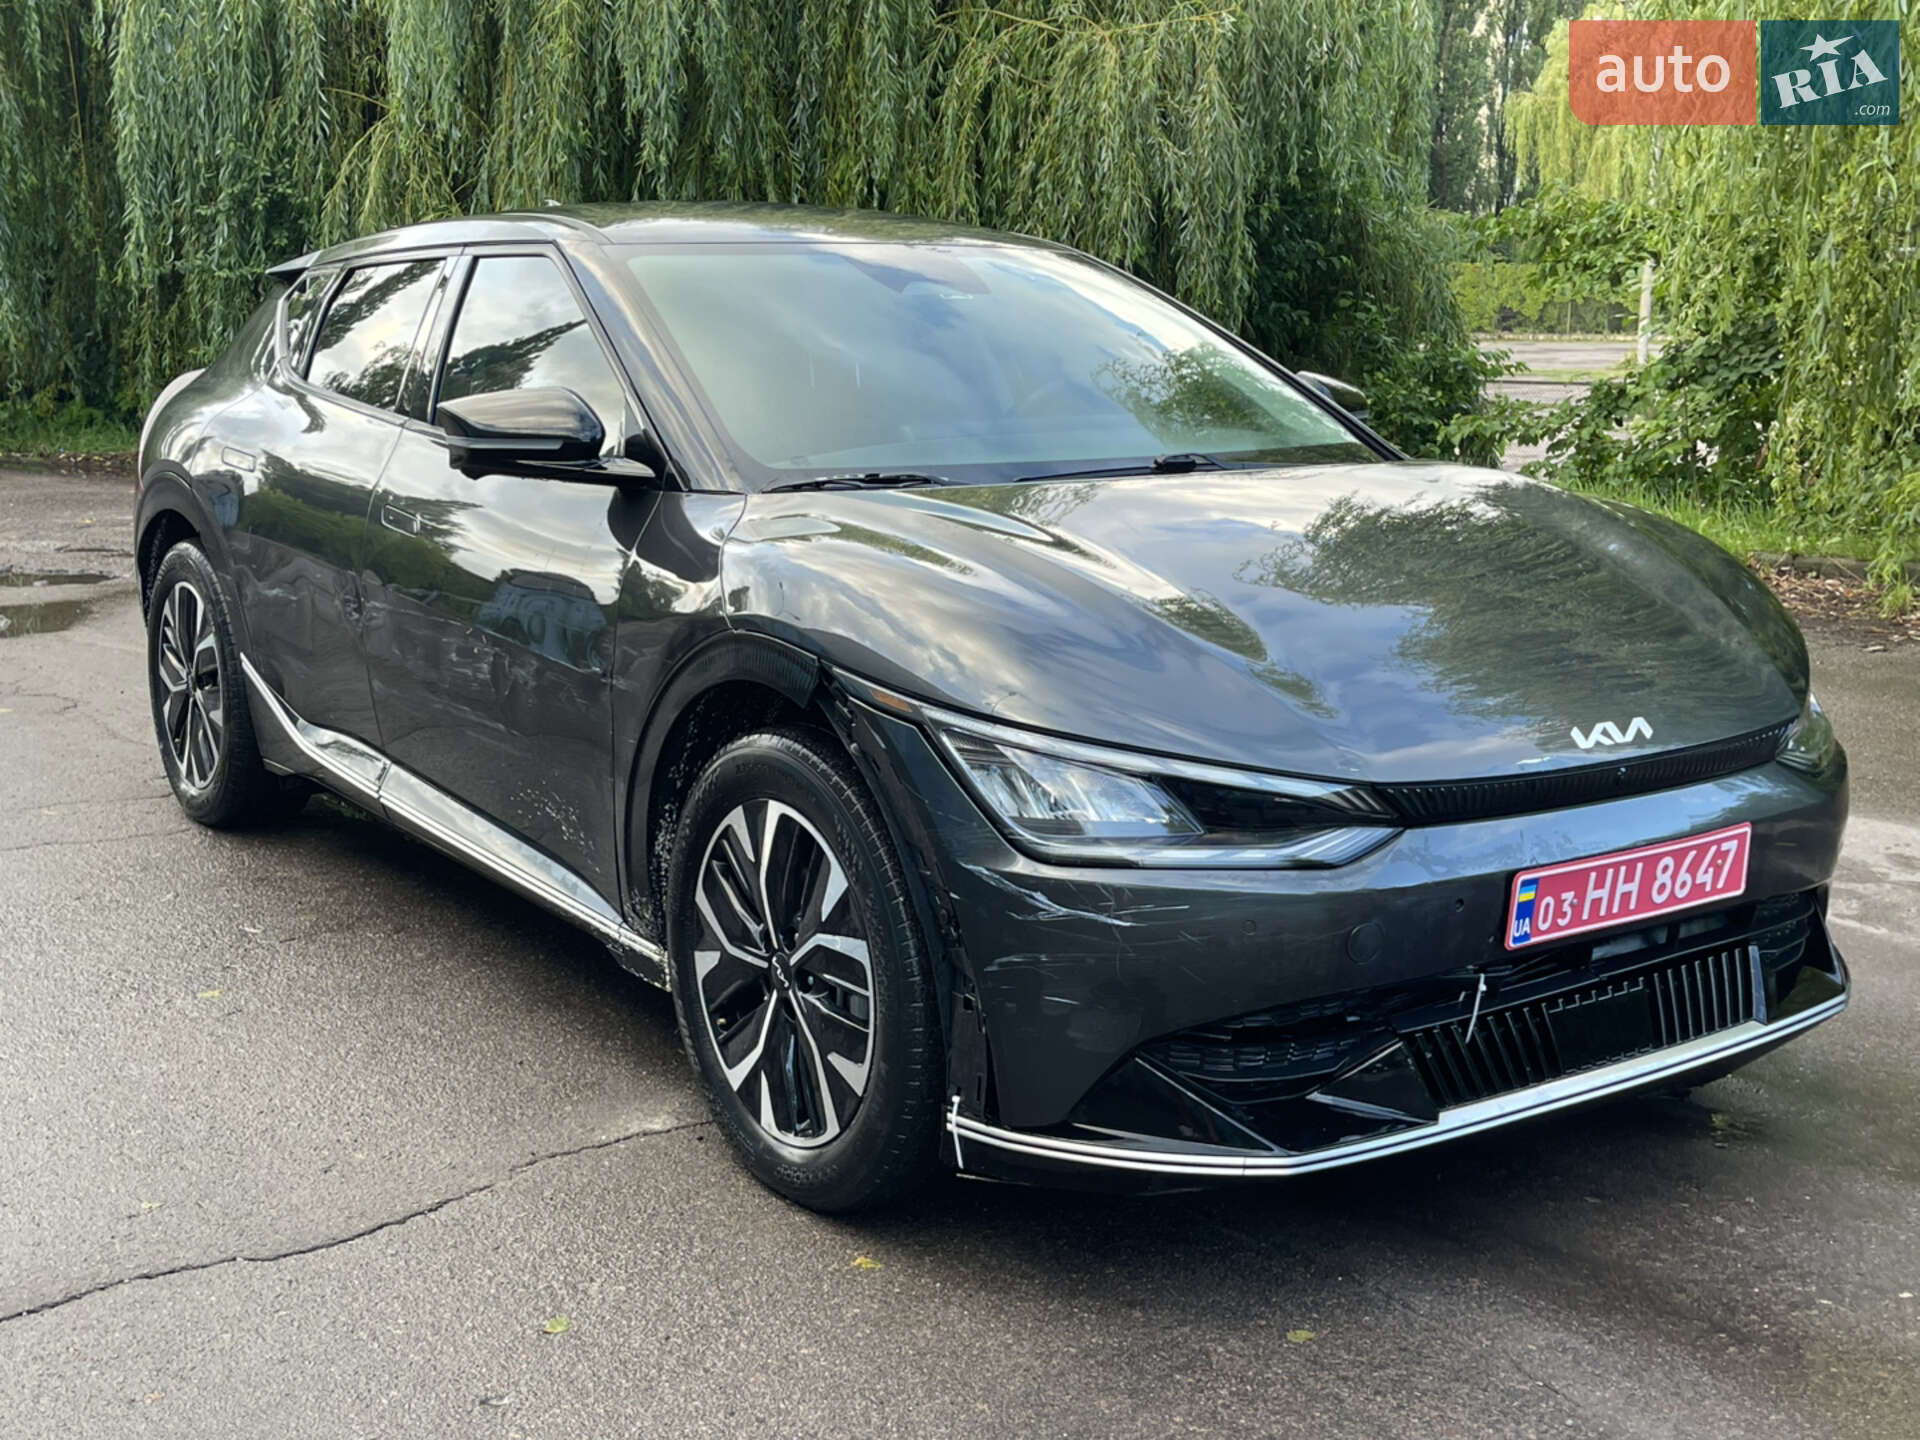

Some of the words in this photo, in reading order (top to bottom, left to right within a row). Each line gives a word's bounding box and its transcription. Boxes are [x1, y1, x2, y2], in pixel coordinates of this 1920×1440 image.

[1570, 716, 1653, 749] KIA
[1537, 891, 1576, 932] 03
[1651, 839, 1739, 905] 8647
[1513, 918, 1532, 938] UA
